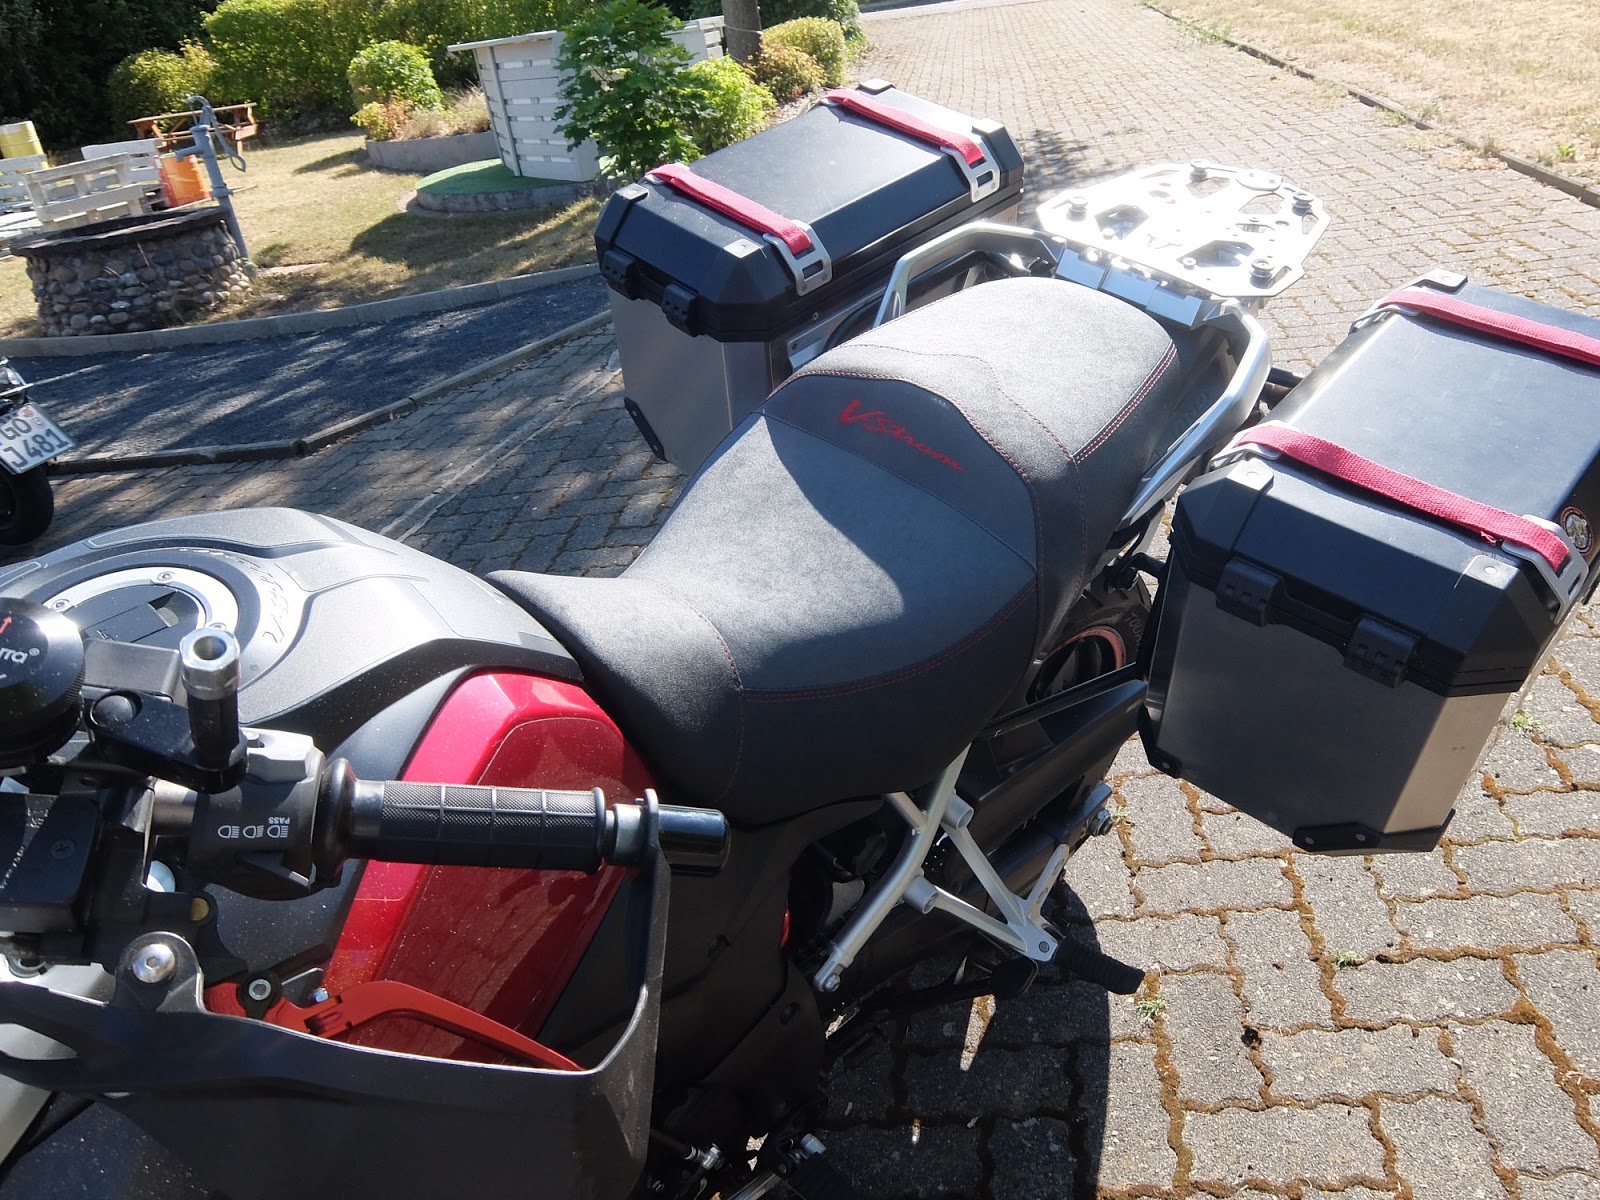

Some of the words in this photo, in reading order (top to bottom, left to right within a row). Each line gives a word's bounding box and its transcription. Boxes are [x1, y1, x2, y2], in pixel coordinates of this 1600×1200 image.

[3, 446, 28, 468] J
[23, 428, 69, 458] 481
[268, 817, 291, 825] PASS
